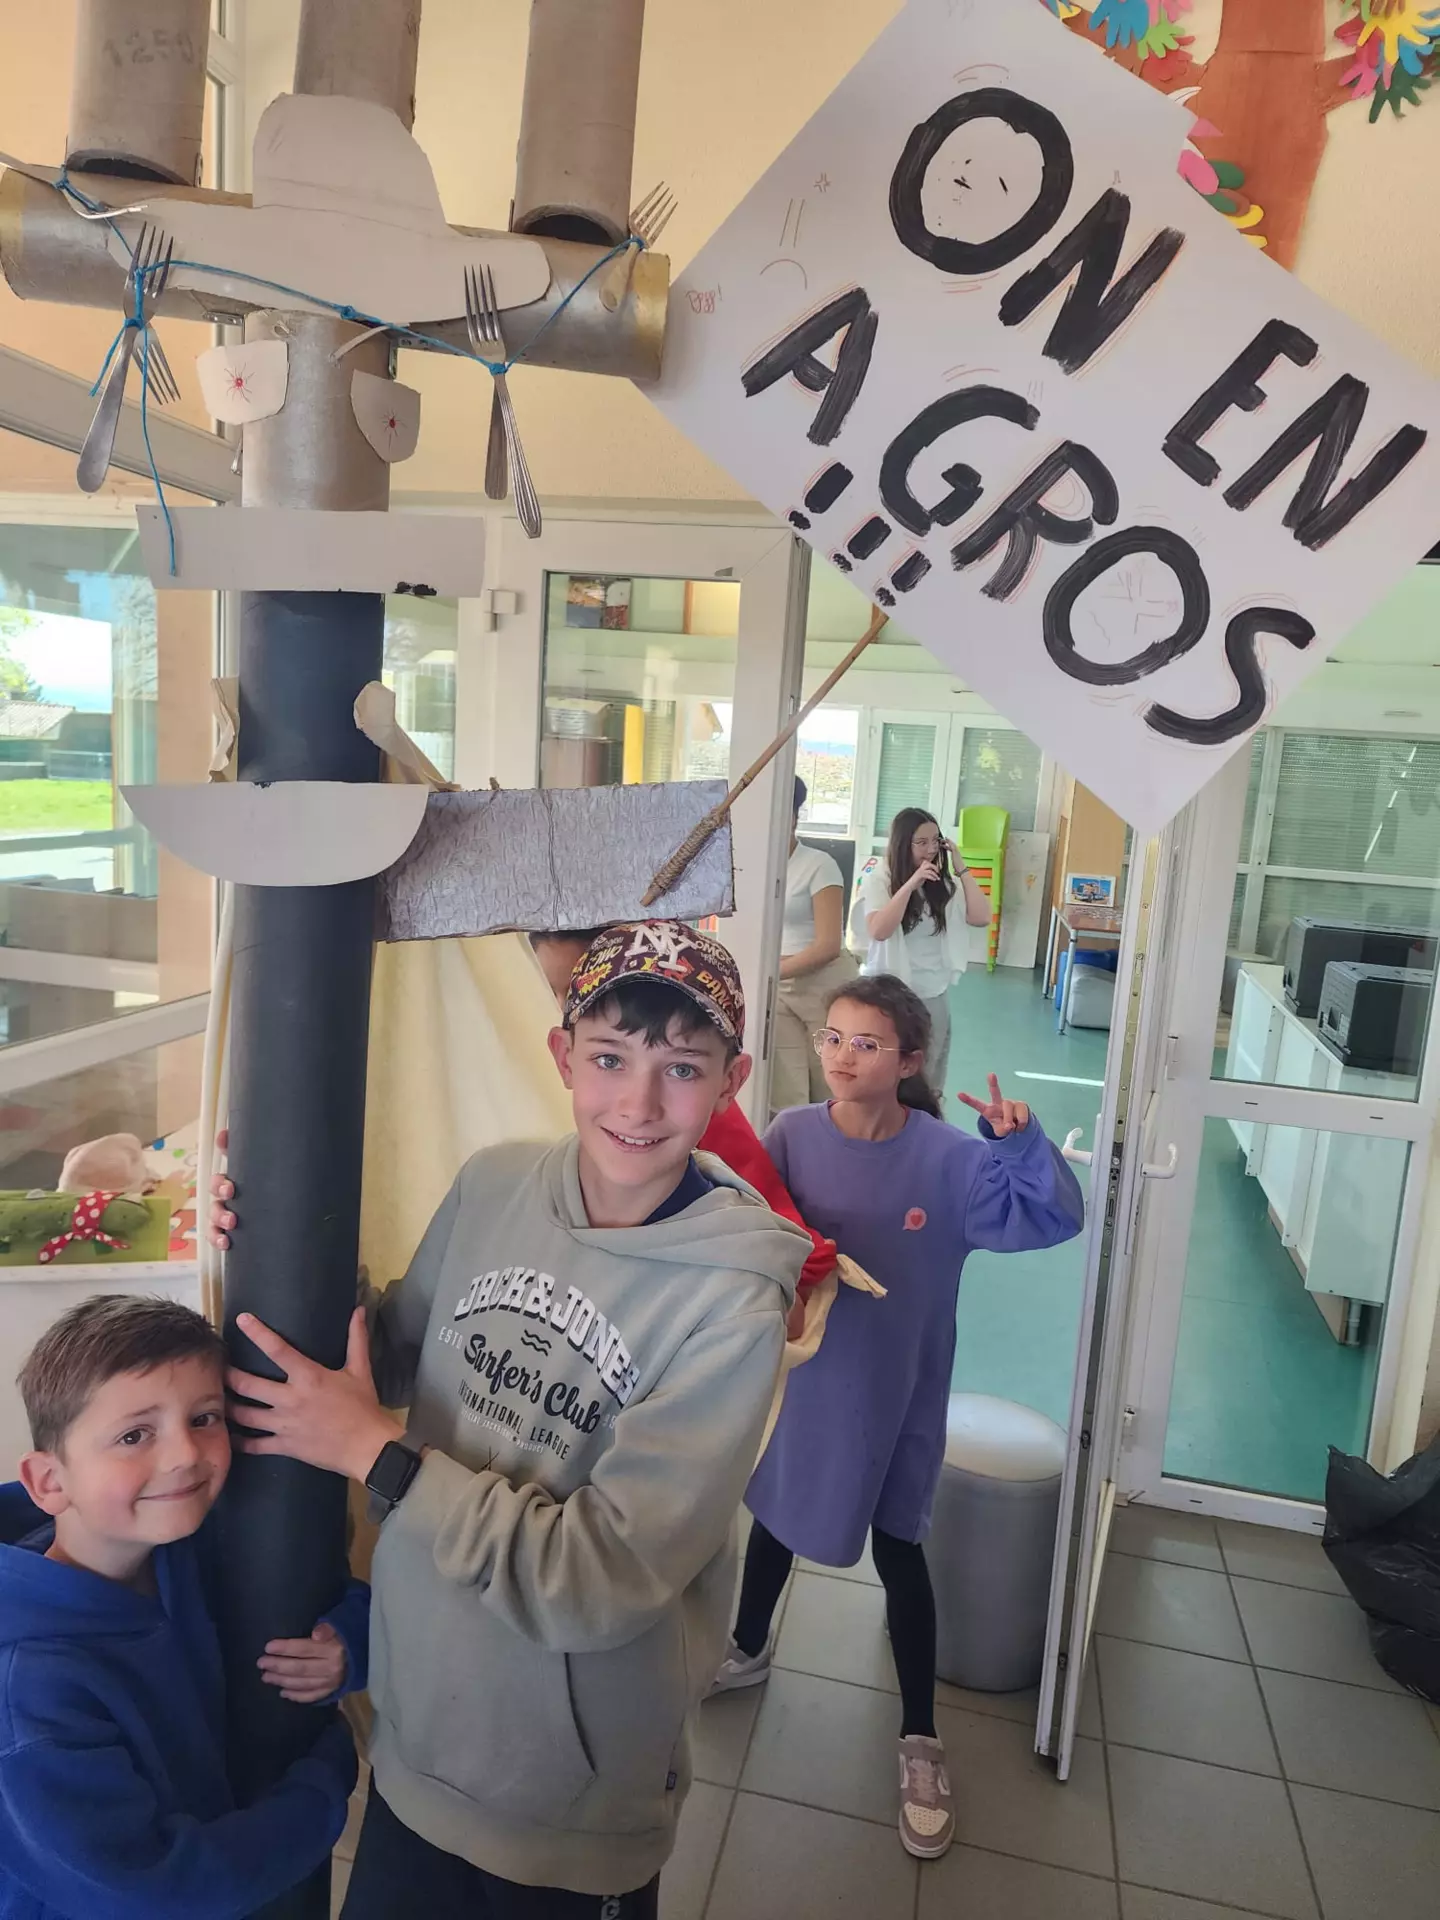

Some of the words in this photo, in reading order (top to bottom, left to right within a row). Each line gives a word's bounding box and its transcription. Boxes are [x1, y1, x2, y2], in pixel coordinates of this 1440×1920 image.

[888, 87, 1186, 374] ON
[1161, 318, 1428, 552] EN
[741, 287, 879, 447] A
[878, 384, 1316, 745] GROS
[464, 1333, 544, 1405] Surfer's
[543, 1382, 601, 1435] Club
[529, 1426, 571, 1460] LEAGUE
